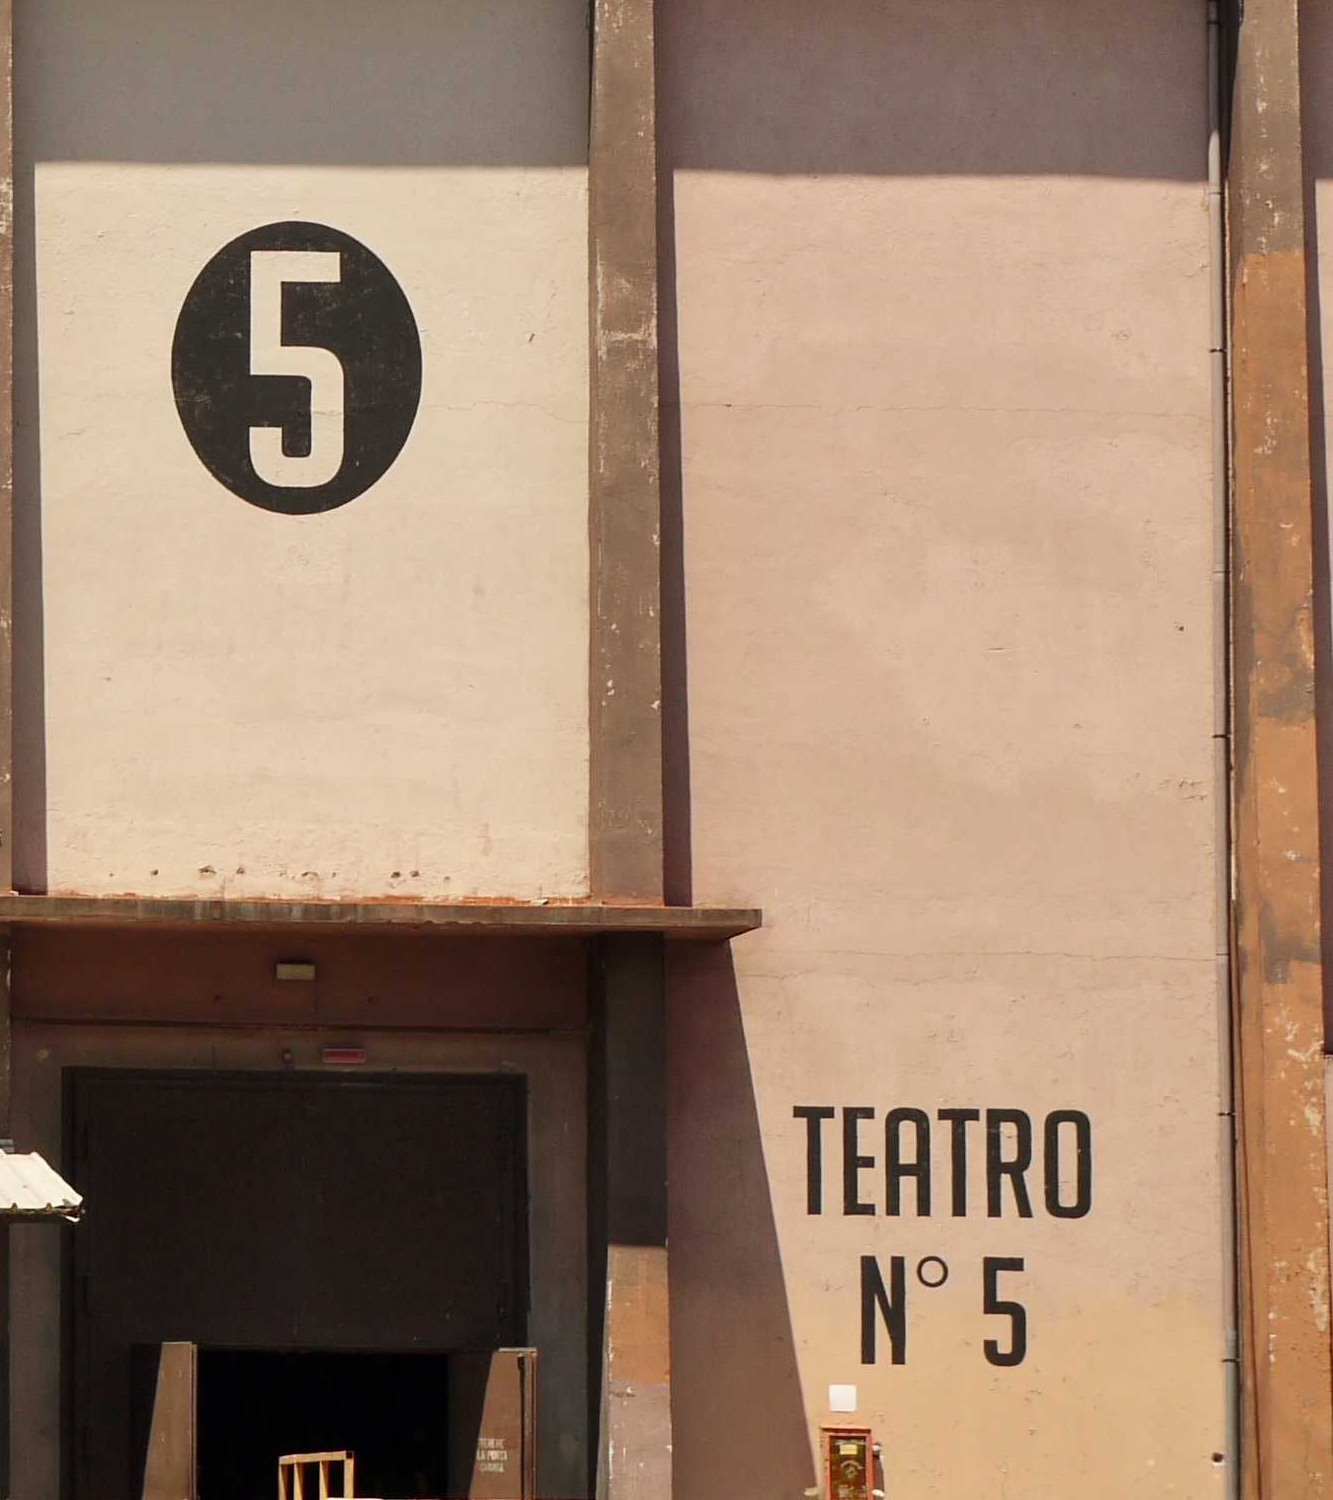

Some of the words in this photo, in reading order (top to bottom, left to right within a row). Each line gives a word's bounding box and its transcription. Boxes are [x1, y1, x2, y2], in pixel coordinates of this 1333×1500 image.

[248, 250, 345, 488] 5
[793, 1105, 1093, 1219] TEATRO
[983, 1256, 1027, 1367] 5
